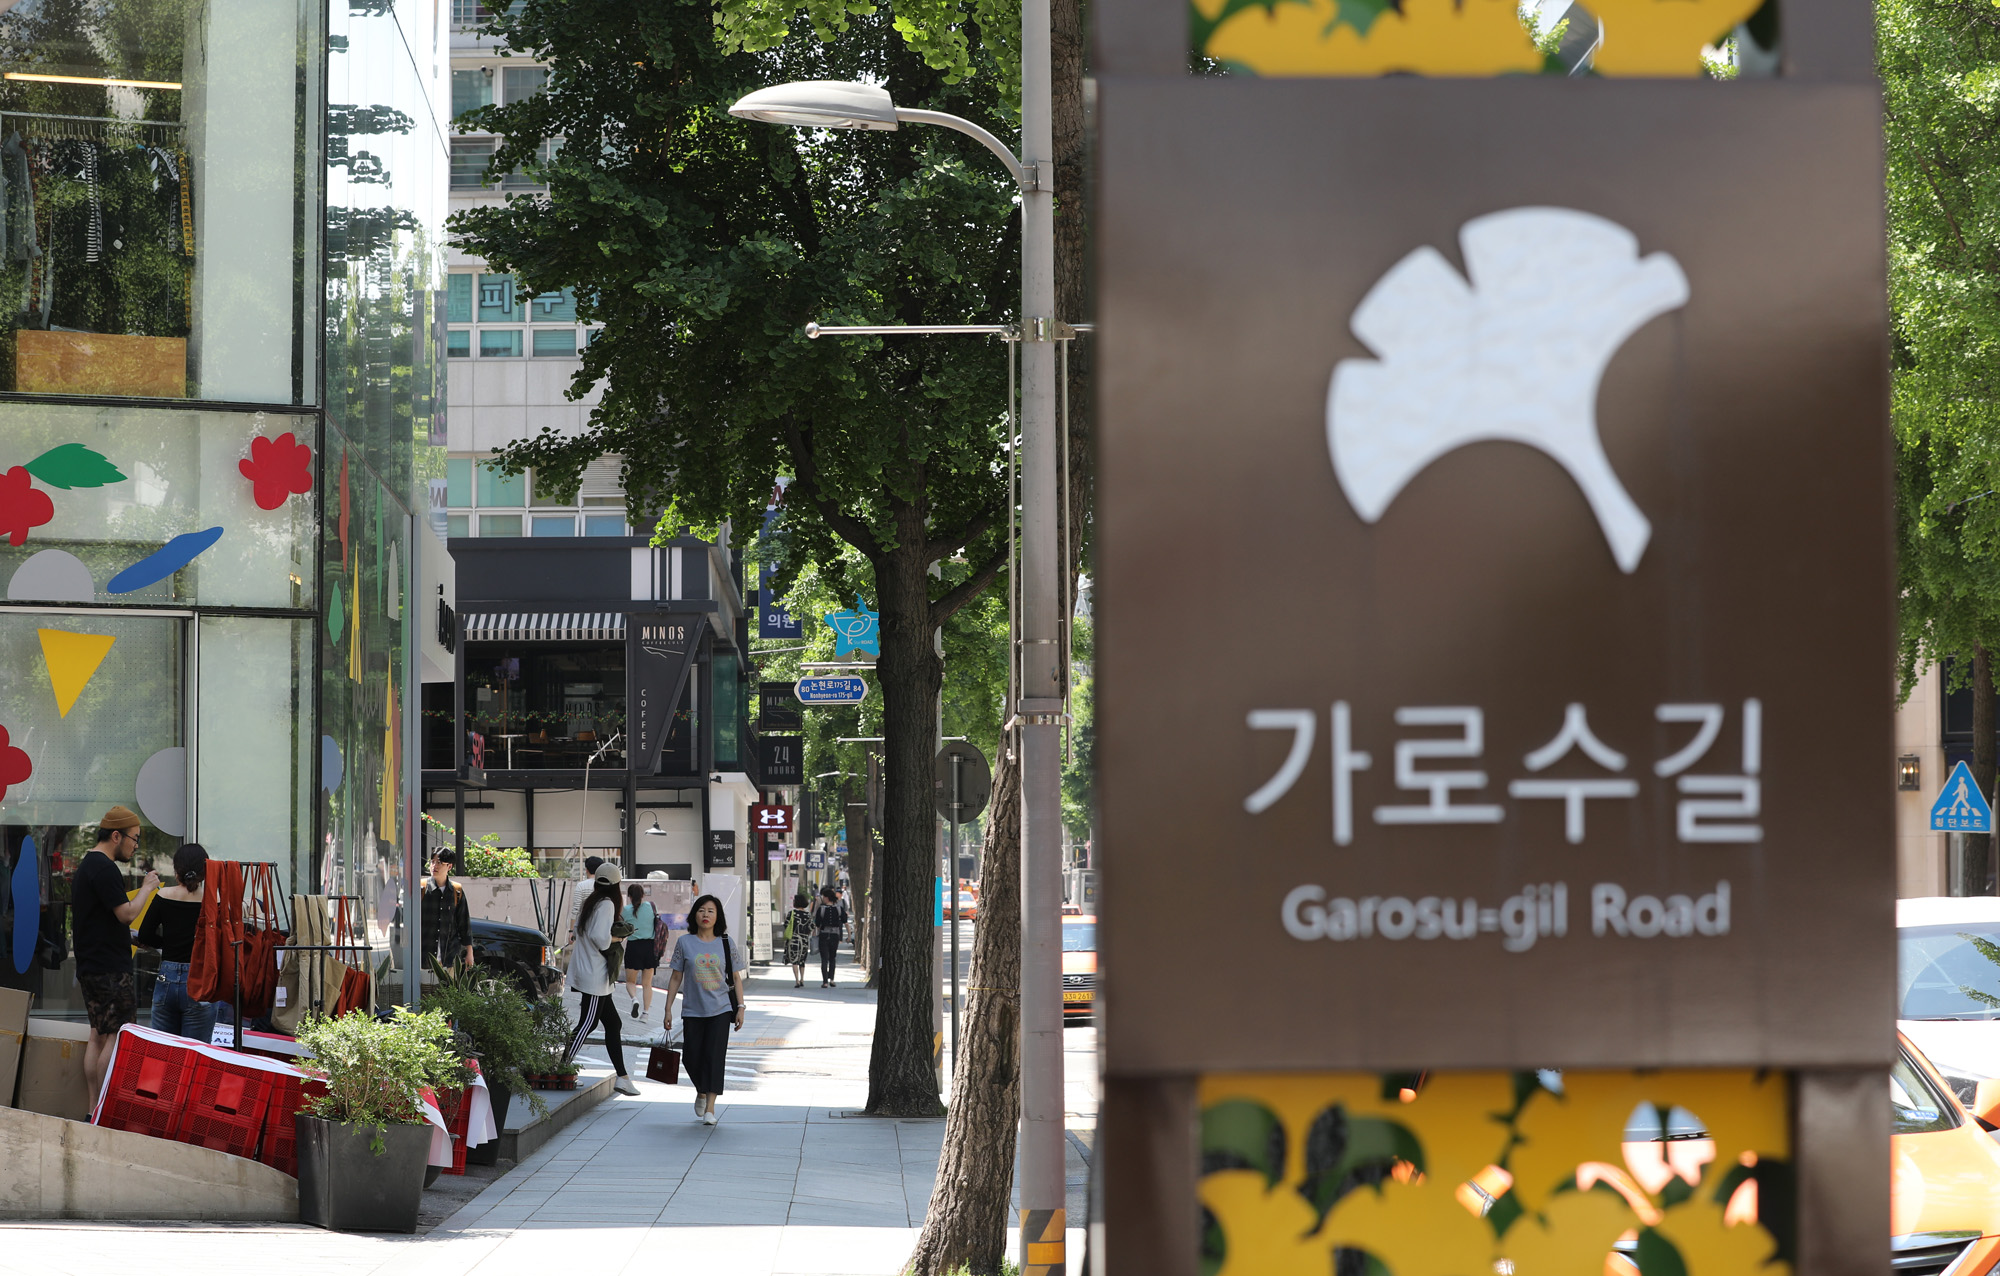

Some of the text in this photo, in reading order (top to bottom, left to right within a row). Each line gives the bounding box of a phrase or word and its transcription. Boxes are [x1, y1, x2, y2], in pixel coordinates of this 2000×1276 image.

[641, 626, 685, 641] MINOS
[810, 680, 851, 691] 논현로175길
[774, 745, 790, 764] 24
[768, 765, 796, 775] HOURS
[1243, 698, 1764, 846] 가로수길
[1935, 817, 1983, 828] 횡단보도
[1281, 881, 1732, 953] Garosu-gil Road
